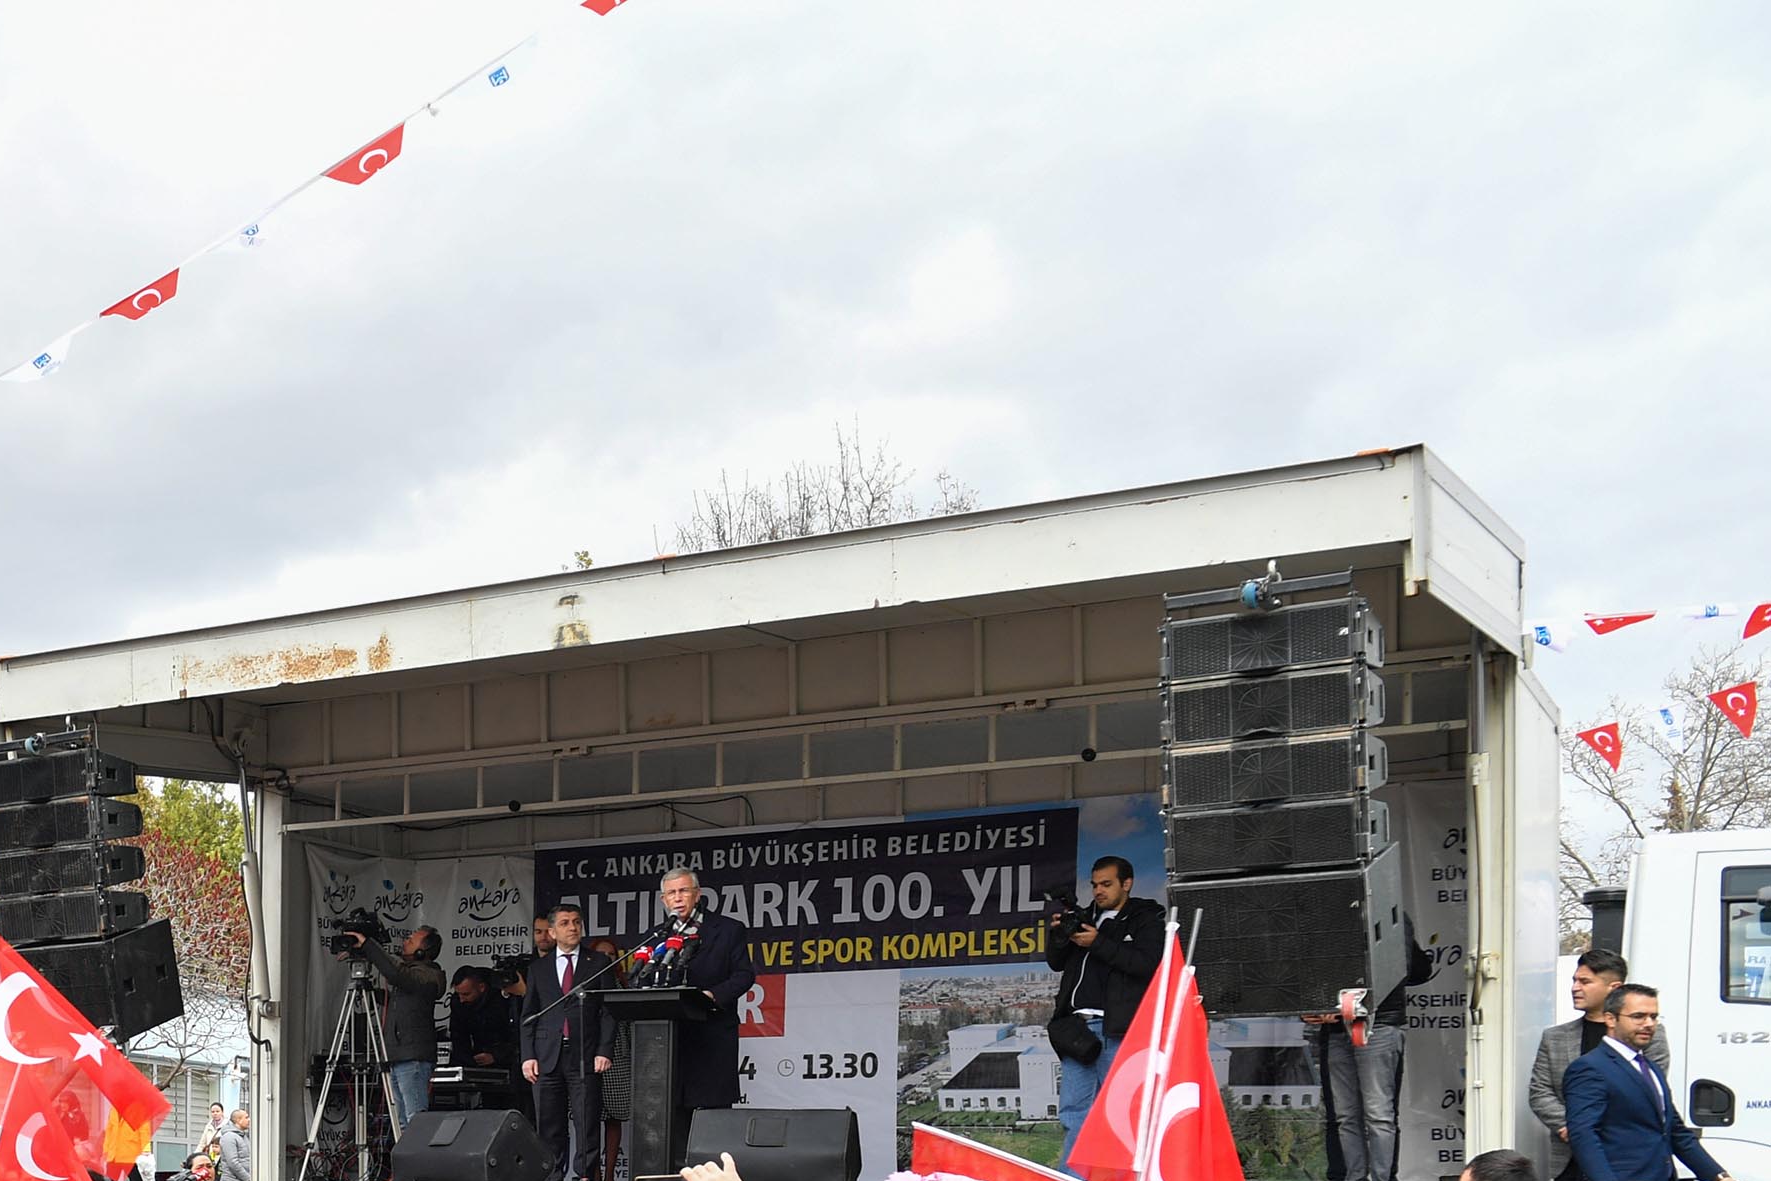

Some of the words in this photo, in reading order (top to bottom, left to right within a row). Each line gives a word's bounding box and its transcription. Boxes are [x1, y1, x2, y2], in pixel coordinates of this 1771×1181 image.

[557, 860, 595, 880] T.C.
[604, 851, 703, 878] ANKARA
[713, 834, 876, 870] BÜYÜKŞEHİR
[887, 818, 1046, 857] BELEDİYESİ
[458, 885, 521, 914] ankara
[832, 872, 944, 924] 100.
[962, 864, 1045, 916] YIL
[452, 924, 528, 940] BÜYÜKŞEHİR
[762, 940, 793, 967] VE
[802, 936, 873, 965] SPOR
[882, 920, 1045, 961] KOMPLEKSİ
[455, 942, 524, 956] BELEDİYESİ
[1406, 991, 1467, 1010] KŞEHİR
[1409, 1012, 1466, 1029] DİYESİ
[803, 1052, 878, 1080] 13.30
